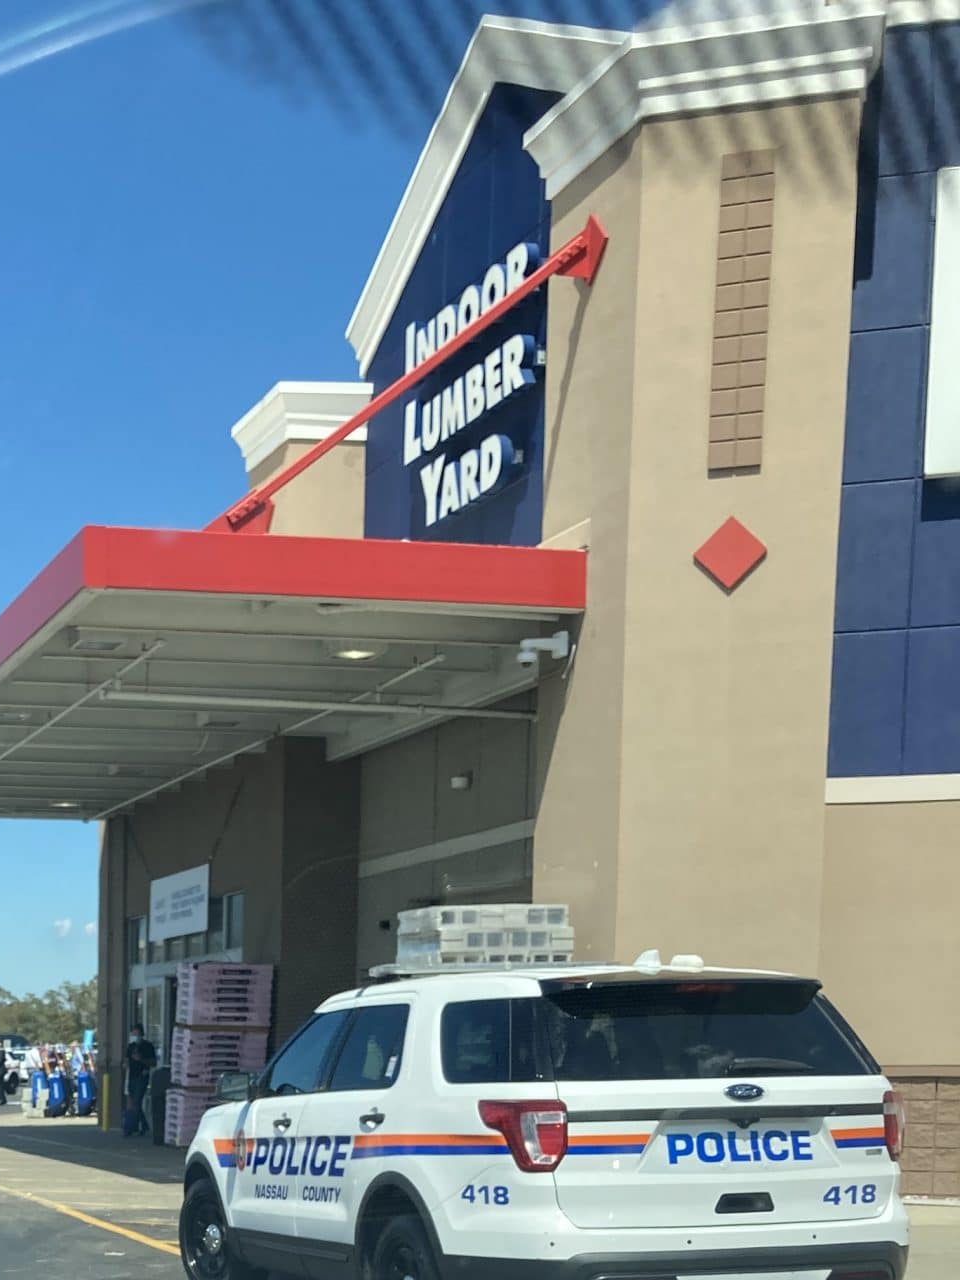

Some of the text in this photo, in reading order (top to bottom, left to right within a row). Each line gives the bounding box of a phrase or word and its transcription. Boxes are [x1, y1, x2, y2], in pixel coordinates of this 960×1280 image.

[404, 241, 529, 375] INDOOR
[403, 333, 527, 467] LUMBER
[419, 433, 504, 527] YARD
[252, 1135, 351, 1177] POLICE
[667, 1129, 814, 1165] POLICE
[255, 1184, 341, 1203] NASSAU COUNTY
[461, 1184, 510, 1206] 418
[823, 1183, 877, 1206] 418
